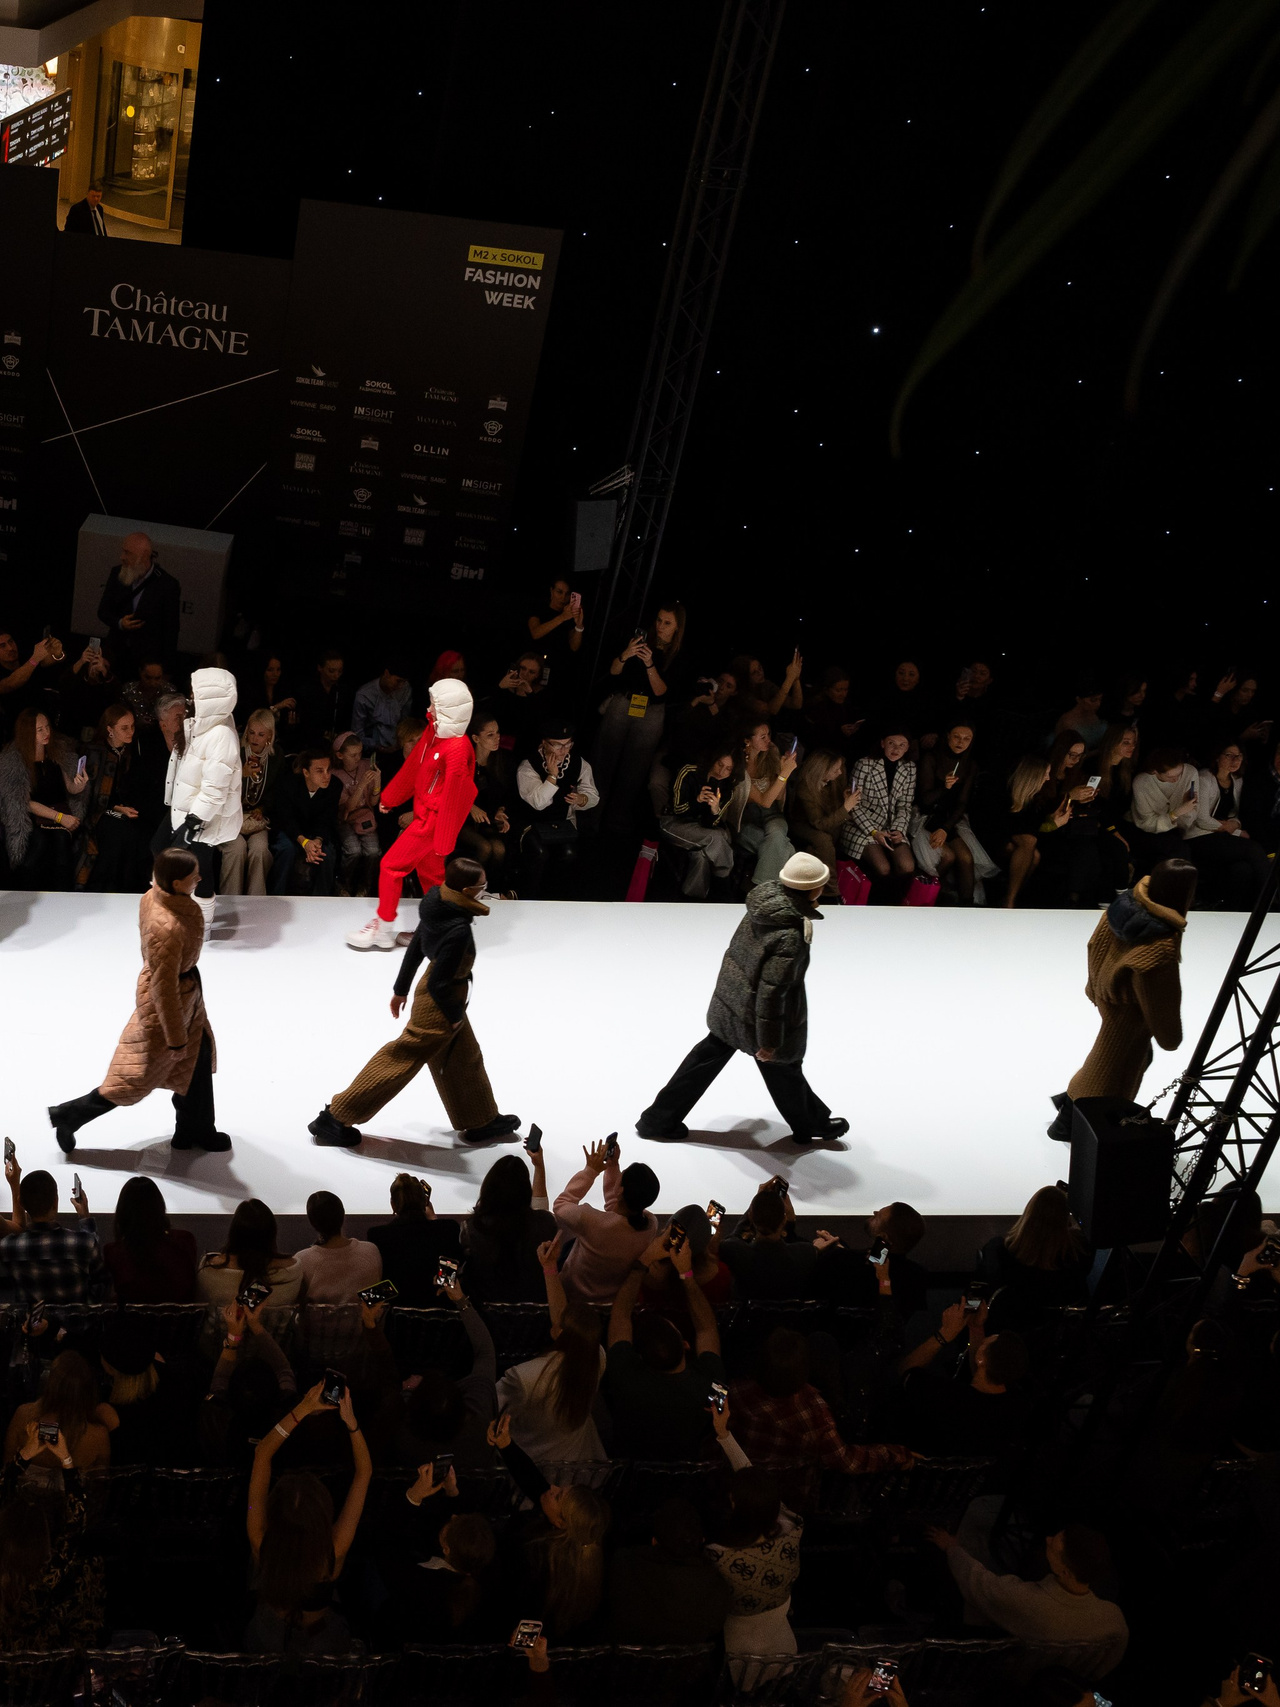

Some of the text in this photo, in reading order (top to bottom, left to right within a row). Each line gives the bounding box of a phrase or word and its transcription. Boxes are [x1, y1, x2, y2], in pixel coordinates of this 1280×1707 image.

[473, 250, 489, 259] M2
[500, 252, 538, 266] SOKOL
[464, 267, 541, 290] FASHION
[110, 283, 228, 322] Château
[484, 290, 537, 310] WEEK
[82, 307, 249, 356] TAMAGNE
[365, 380, 392, 390] SOKOL
[290, 399, 318, 408] VIVIENNE
[354, 406, 395, 420] INSIGHT
[296, 427, 322, 438] SOKOL
[479, 436, 502, 444] KEDDO
[413, 444, 450, 456] OLLIN
[296, 454, 316, 463] MINI
[294, 461, 314, 471] BAR
[400, 472, 427, 481] VIVIENNE
[462, 478, 503, 491] INSIGHT
[404, 536, 424, 545] BAR
[450, 566, 484, 580] girl
